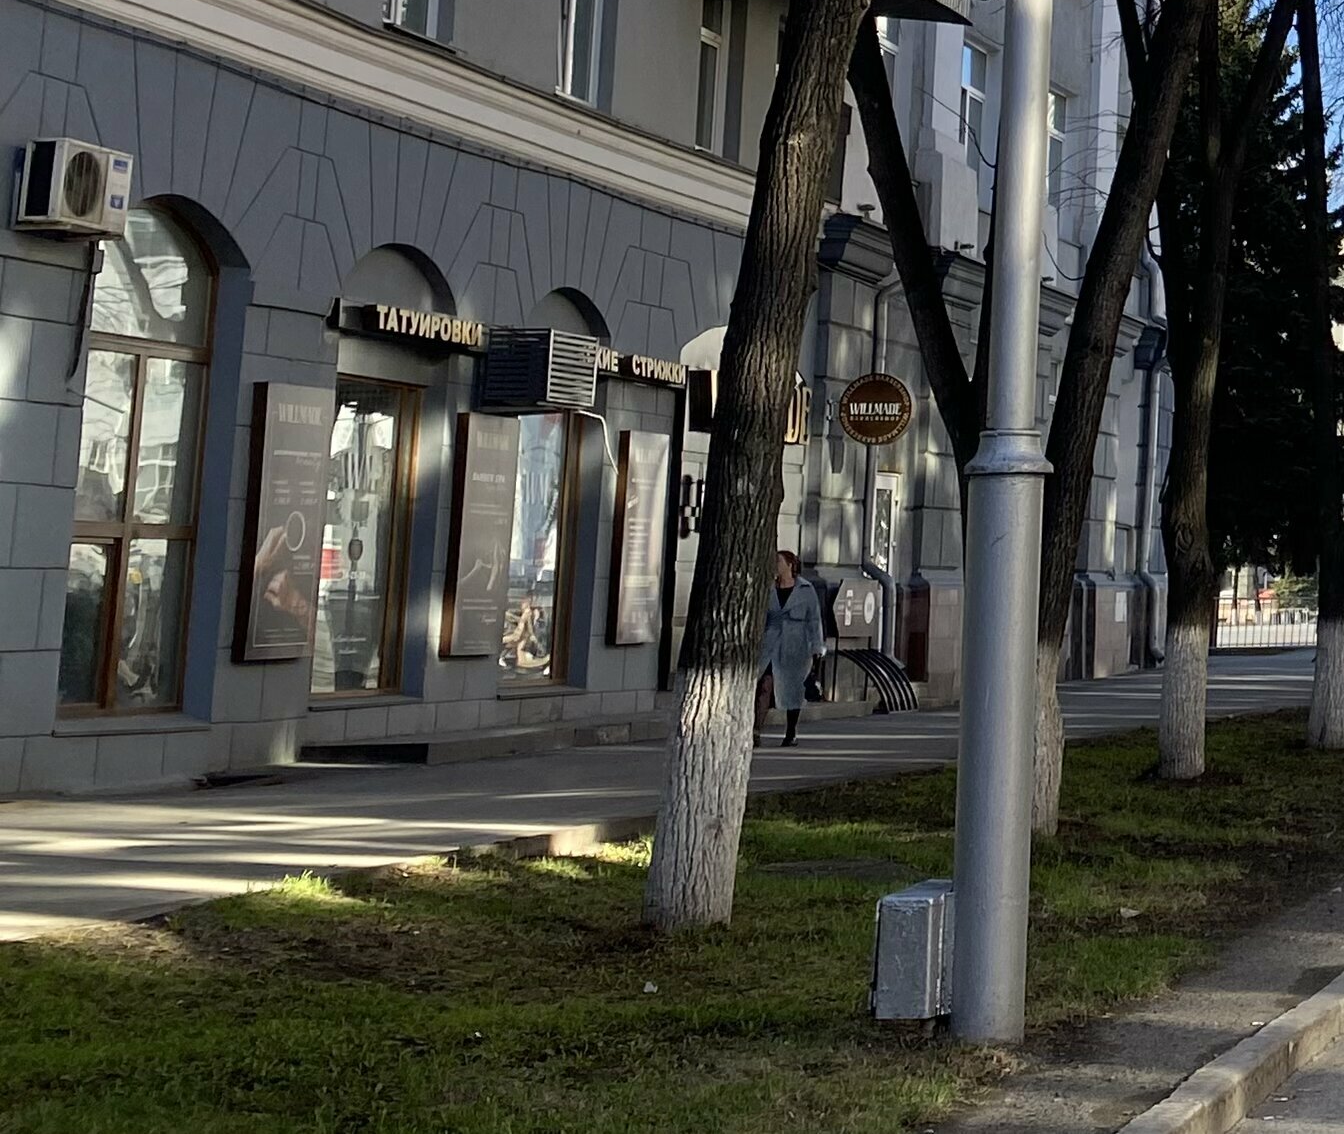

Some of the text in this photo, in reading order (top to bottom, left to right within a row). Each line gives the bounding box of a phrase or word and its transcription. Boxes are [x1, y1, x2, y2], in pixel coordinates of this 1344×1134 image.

[376, 304, 483, 346] ТАТУИРОВКИ
[632, 353, 686, 385] СТРИЖКИ
[850, 402, 902, 415] WILLMADE
